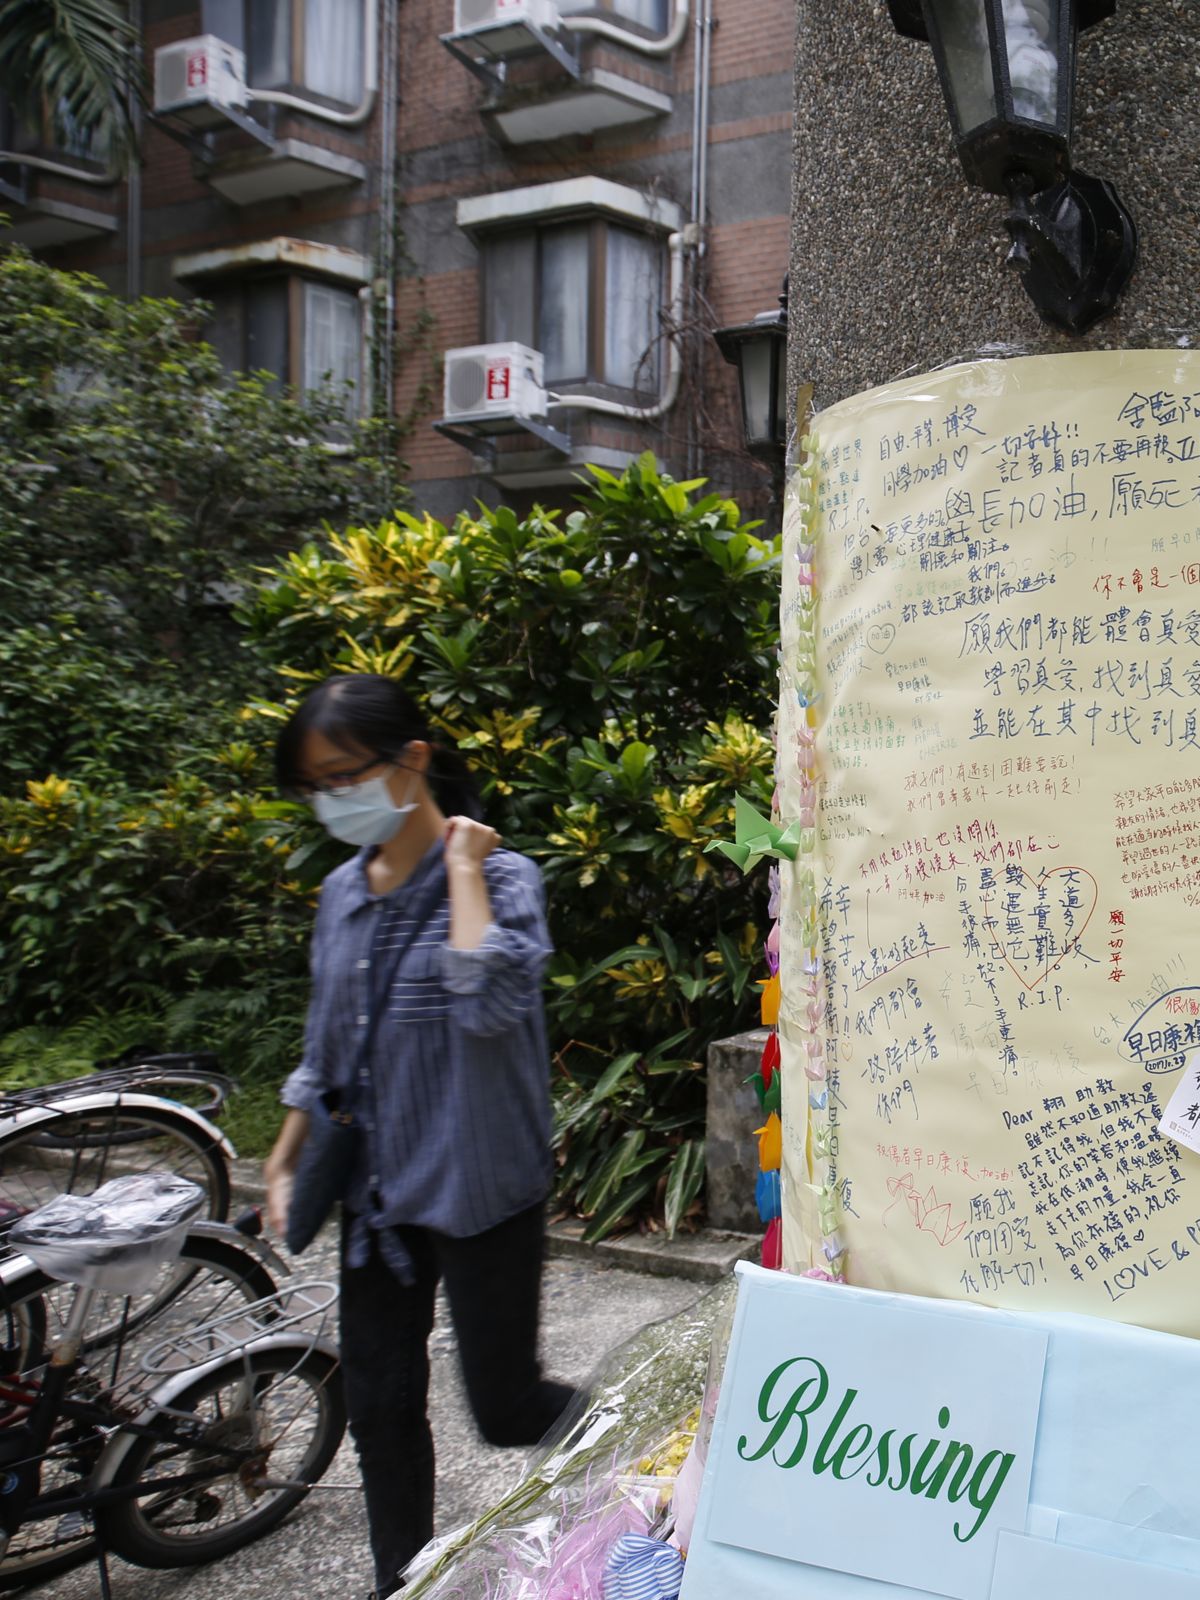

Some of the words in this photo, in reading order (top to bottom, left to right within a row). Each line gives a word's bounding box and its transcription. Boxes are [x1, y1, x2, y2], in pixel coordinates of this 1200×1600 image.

[1108, 909, 1126, 983] 願一切平安
[1002, 1108, 1035, 1131] Dear
[1172, 1240, 1190, 1262] &
[737, 1356, 1016, 1542] Blessing
